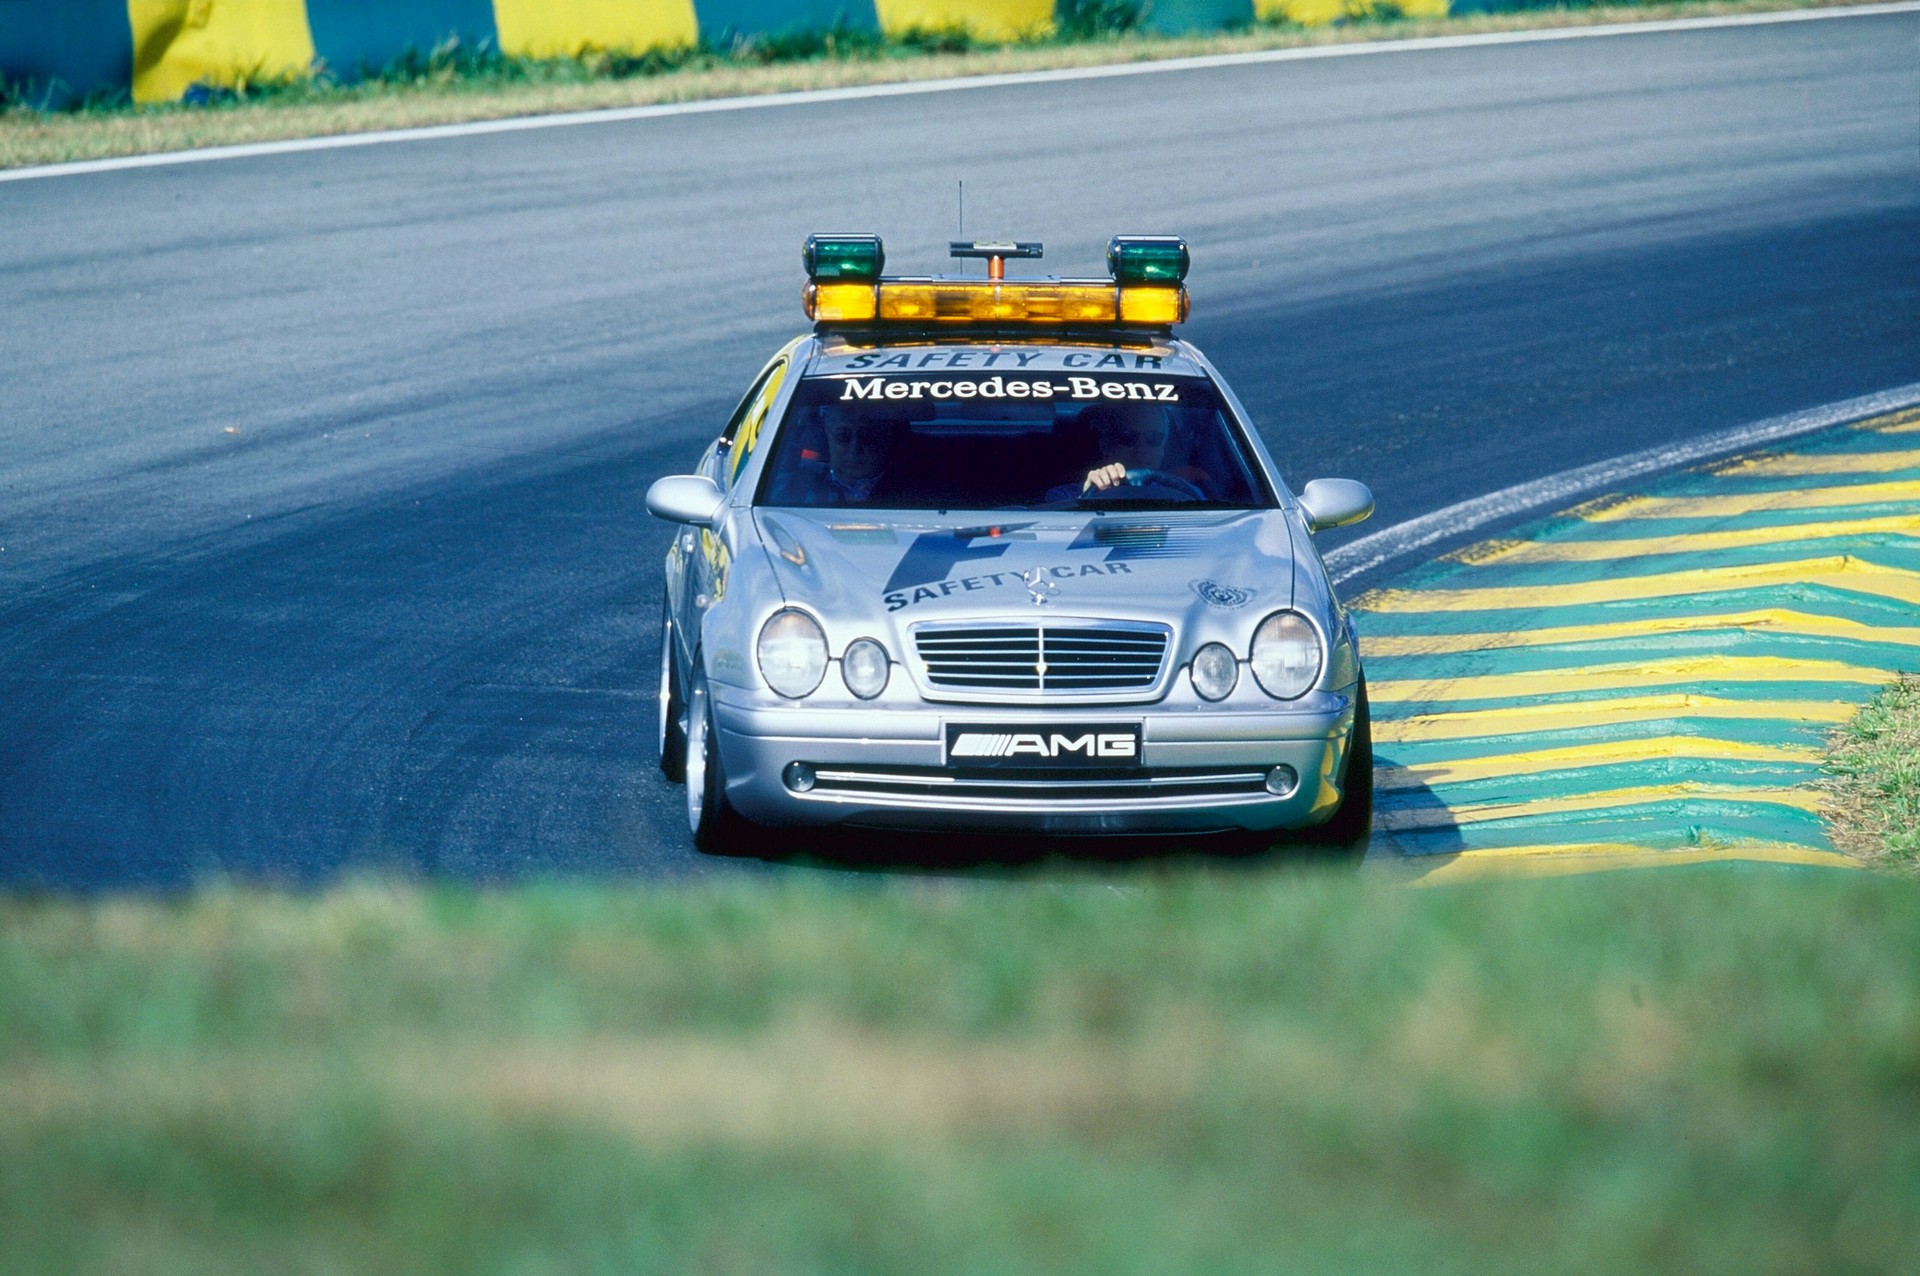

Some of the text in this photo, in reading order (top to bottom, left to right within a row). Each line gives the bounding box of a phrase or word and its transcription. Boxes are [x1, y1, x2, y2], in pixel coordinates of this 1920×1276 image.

[845, 352, 1163, 370] SAFETY CAR
[840, 376, 1179, 401] Mercedes-Benz
[1050, 562, 1133, 579] CAR
[1004, 734, 1136, 756] AMG
